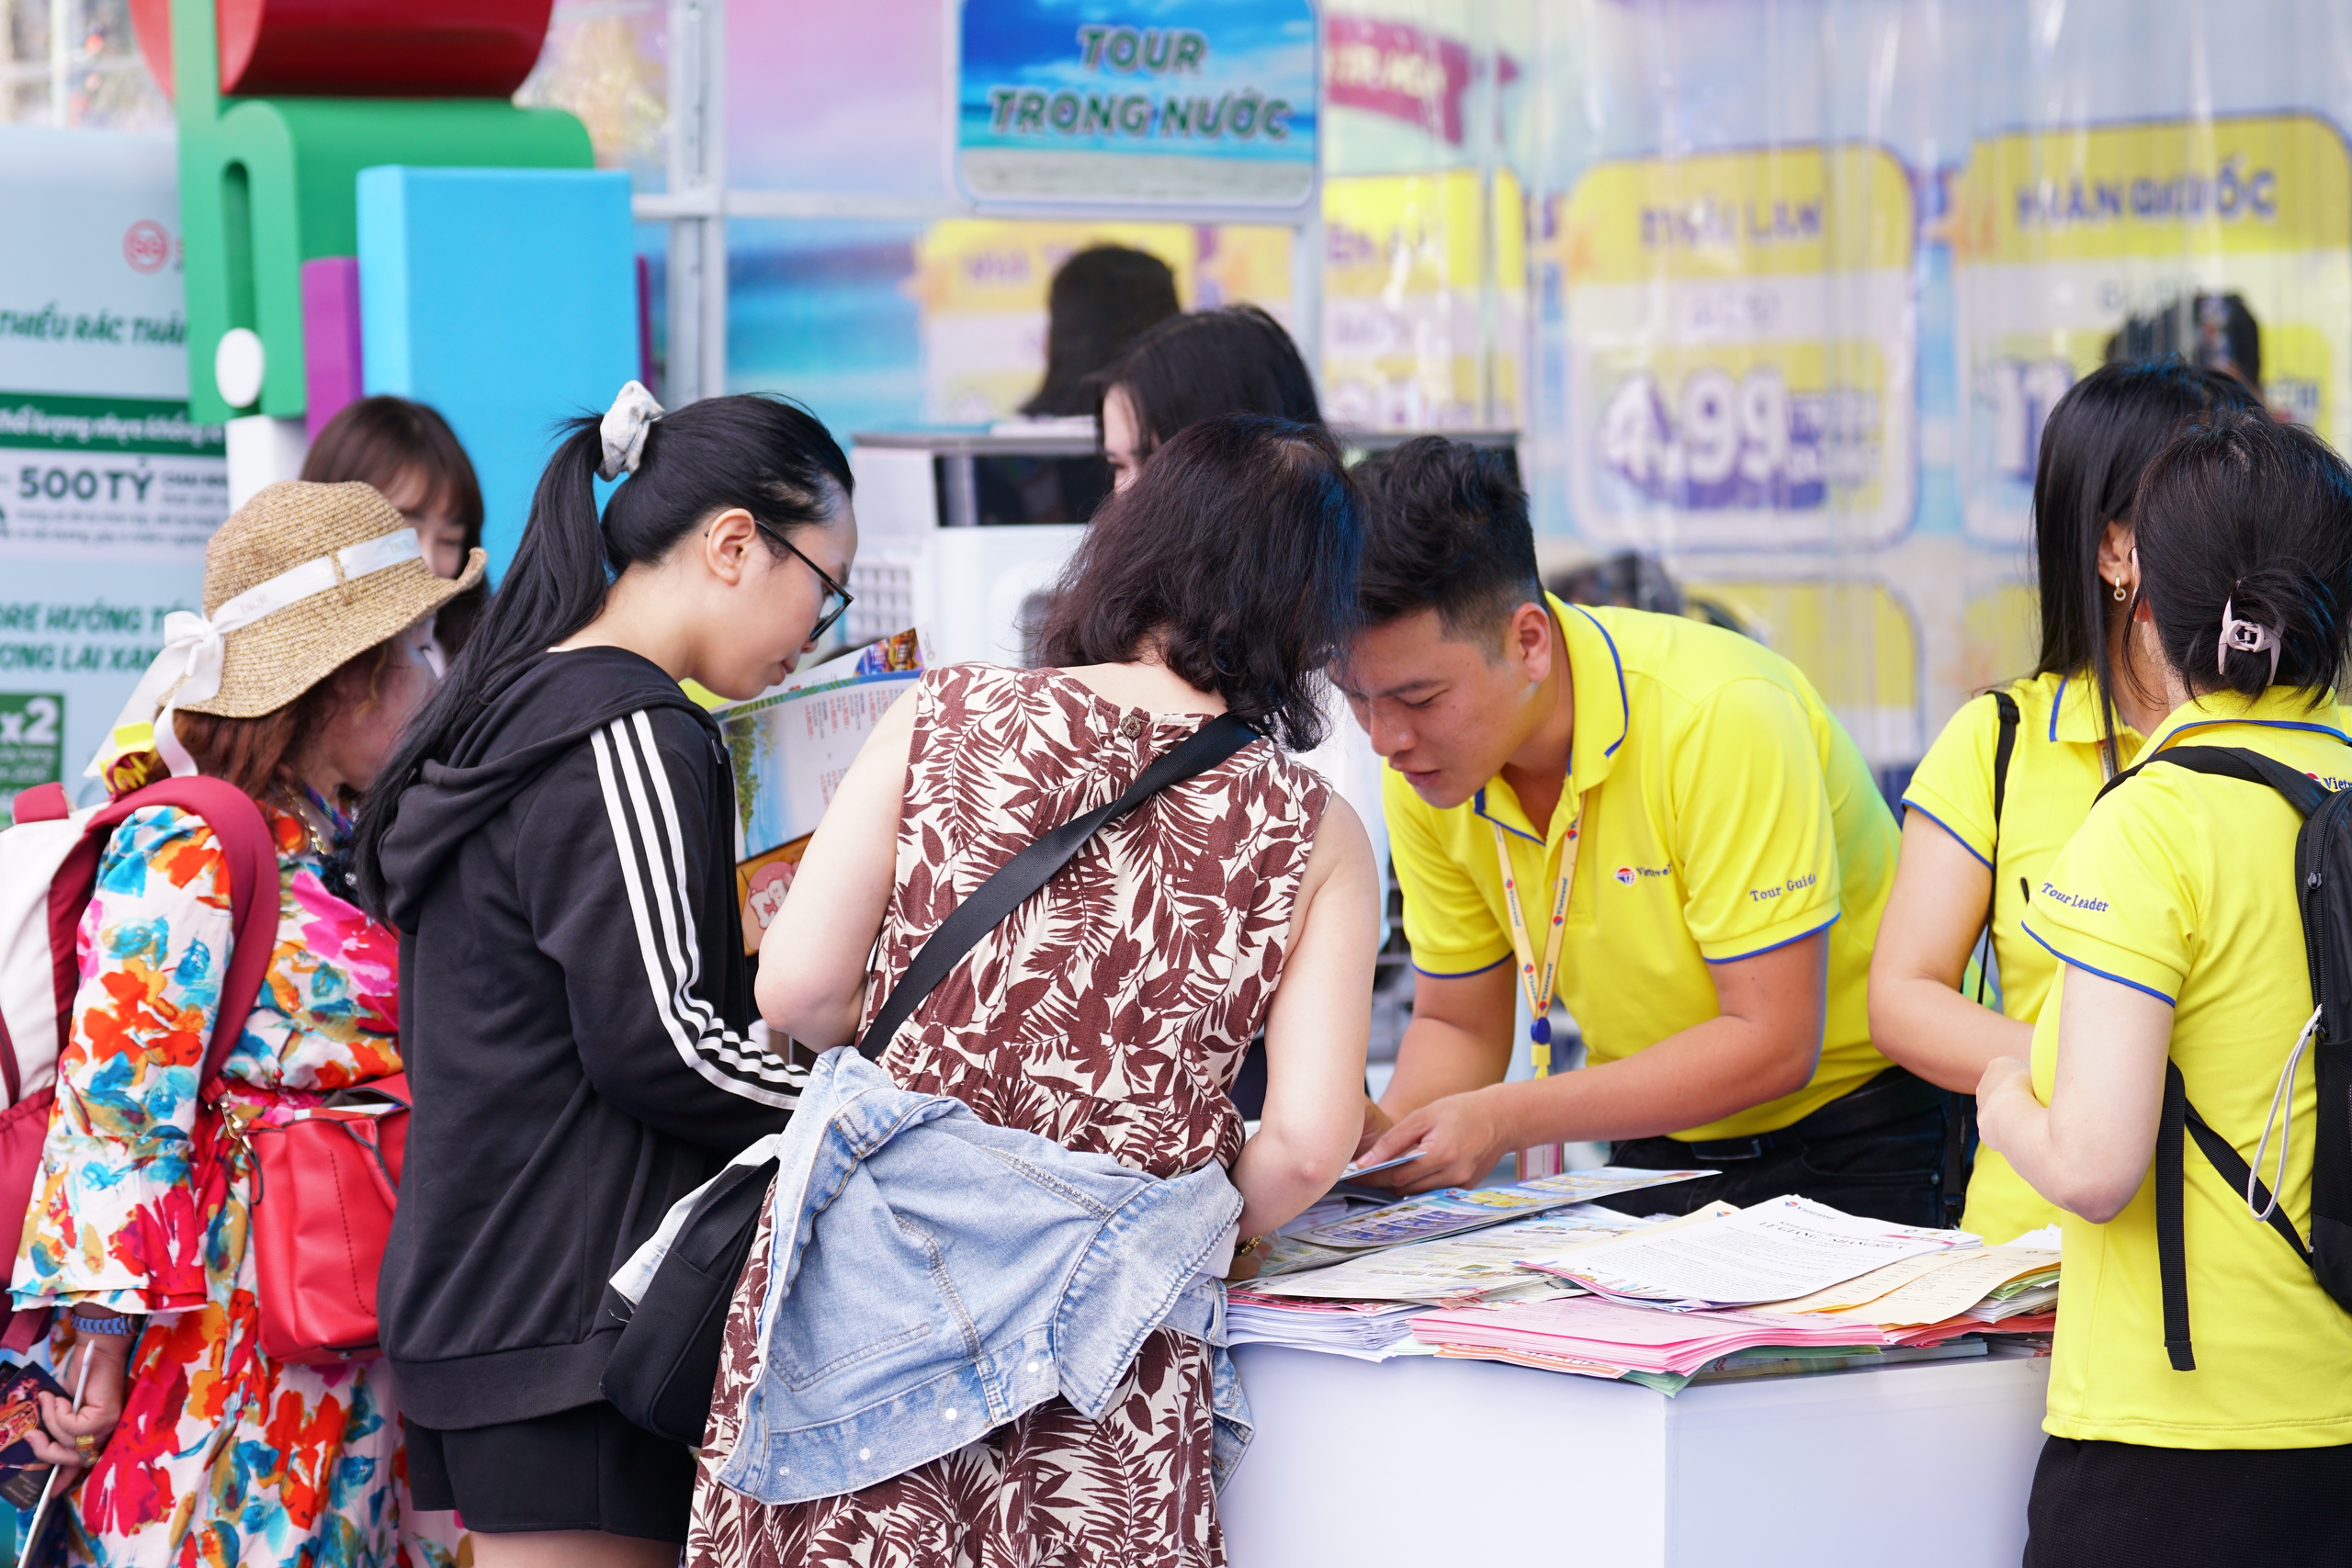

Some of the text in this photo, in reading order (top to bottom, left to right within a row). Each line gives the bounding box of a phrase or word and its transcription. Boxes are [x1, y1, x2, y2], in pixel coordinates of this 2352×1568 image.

[1079, 28, 1207, 73] TOUR
[990, 85, 1294, 140] TRONG NƯỚC
[18, 465, 98, 501] 500
[239, 593, 268, 615] DIOR
[61, 644, 102, 672] LAI
[0, 696, 59, 746] x2
[1749, 886, 1782, 902] Tour
[2041, 882, 2109, 912] Tour Leader
